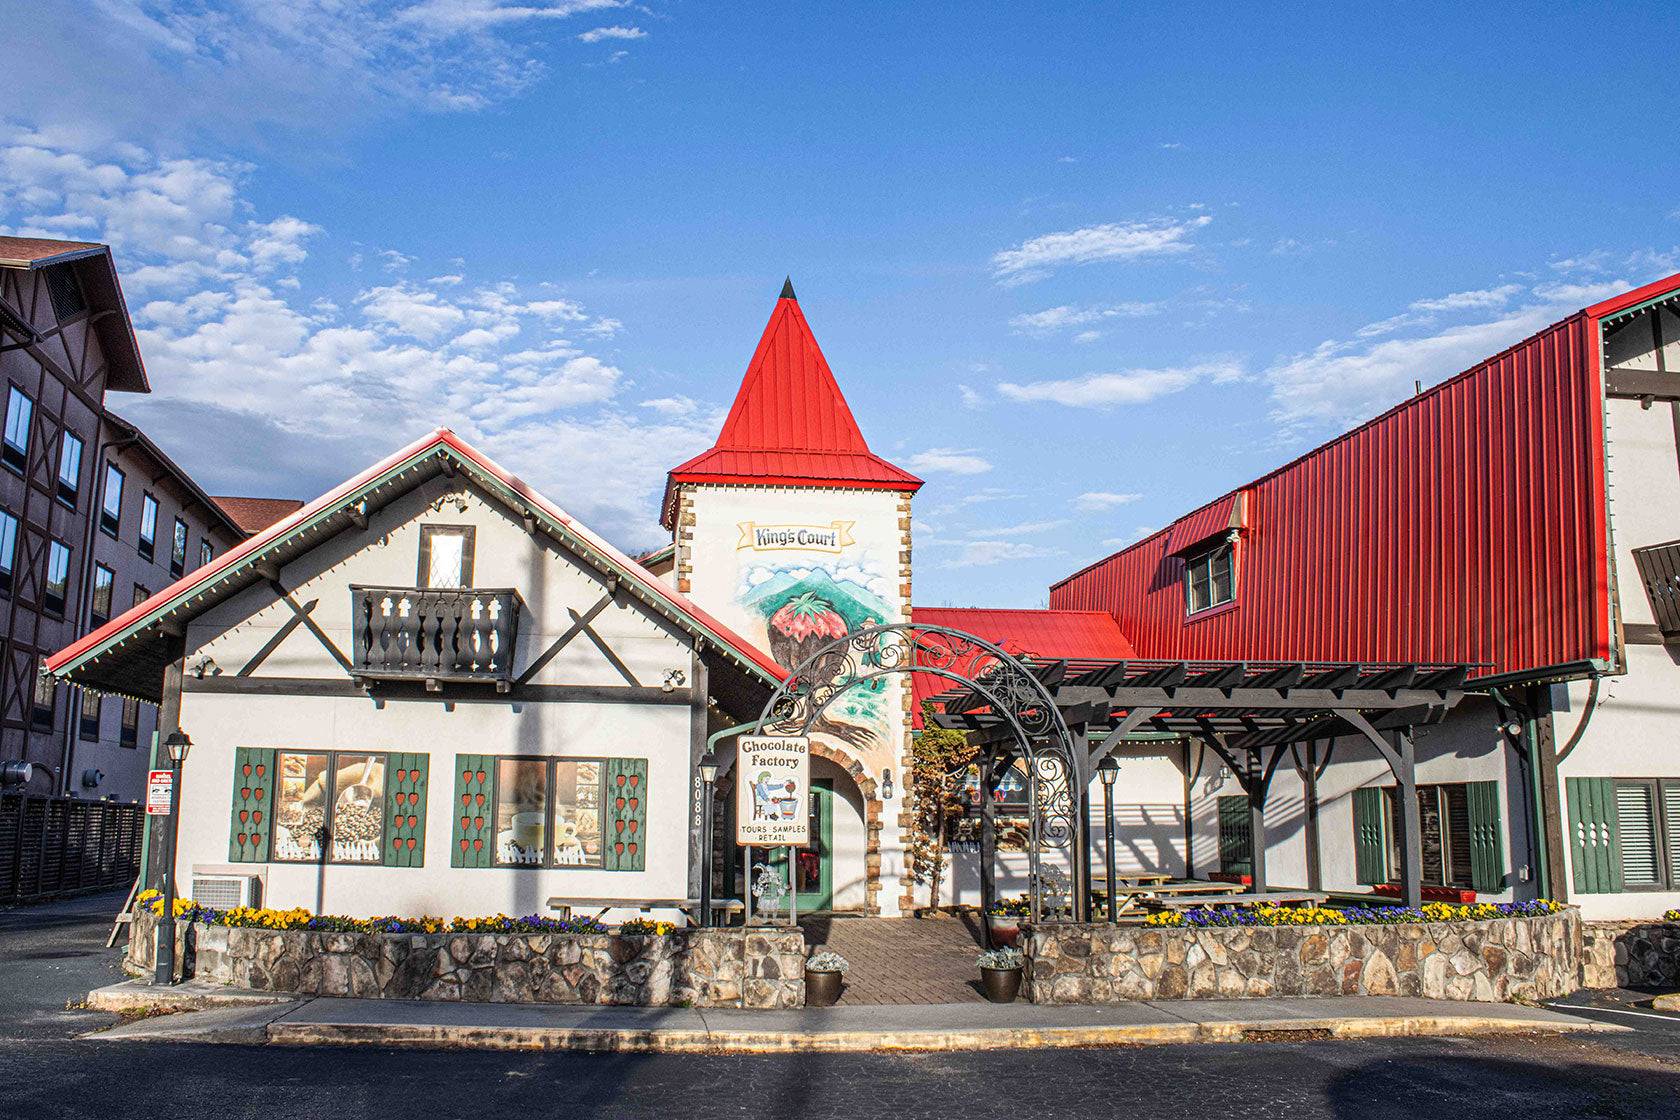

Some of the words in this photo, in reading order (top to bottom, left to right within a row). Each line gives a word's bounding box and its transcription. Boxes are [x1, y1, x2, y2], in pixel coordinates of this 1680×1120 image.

[756, 528, 795, 546] King's
[797, 528, 836, 546] Court
[742, 740, 806, 753] Chocolate
[752, 755, 799, 769] Factory
[971, 790, 1005, 803] ON
[741, 825, 767, 833] TOURS
[772, 825, 806, 833] SAMPLES
